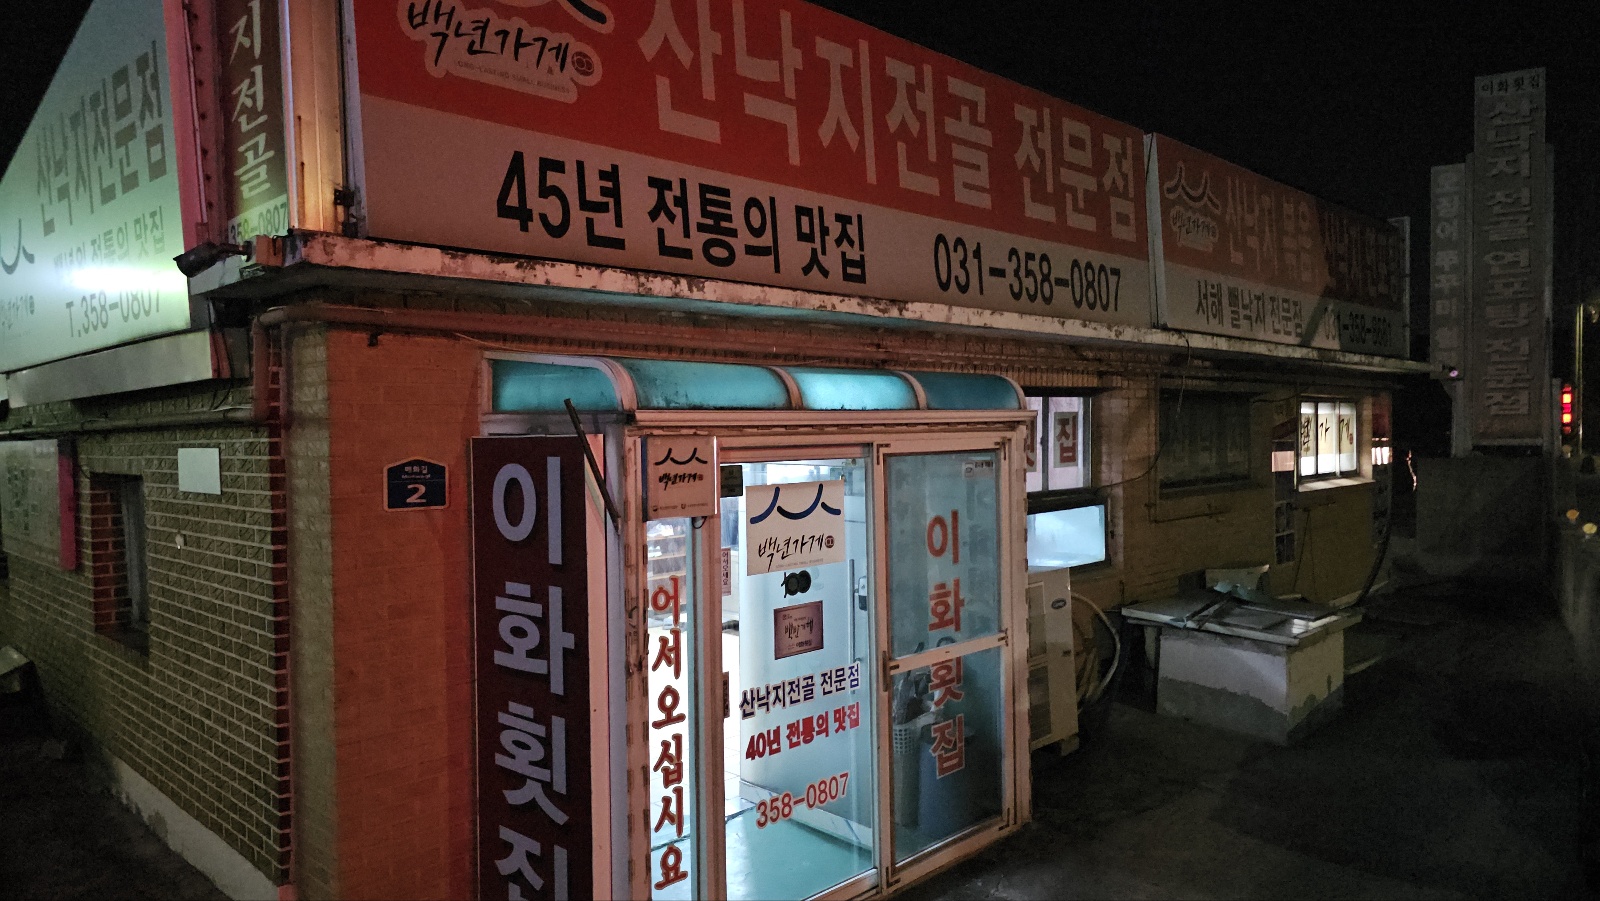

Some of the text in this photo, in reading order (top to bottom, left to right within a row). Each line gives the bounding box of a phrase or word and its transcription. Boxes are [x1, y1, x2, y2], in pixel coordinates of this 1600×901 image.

[408, 0, 570, 73] 백년가게
[1481, 73, 1540, 95] 이화횟집
[637, 0, 1137, 243] 산낙지전골 전문점
[134, 205, 166, 262] 맛집
[231, 202, 288, 244] 358-0807
[495, 150, 868, 285] 45년 전통의 맛집
[933, 233, 1121, 312] 031-358-0807
[1196, 279, 1224, 327] 서해
[406, 483, 427, 503] 2
[658, 472, 698, 491] 백년가게
[758, 533, 825, 573] 백년가게
[740, 675, 815, 719] 산낙지전골
[820, 663, 860, 696] 전문점
[745, 702, 860, 761] 40년 전통의 맛집
[756, 772, 849, 829] 358-0807
